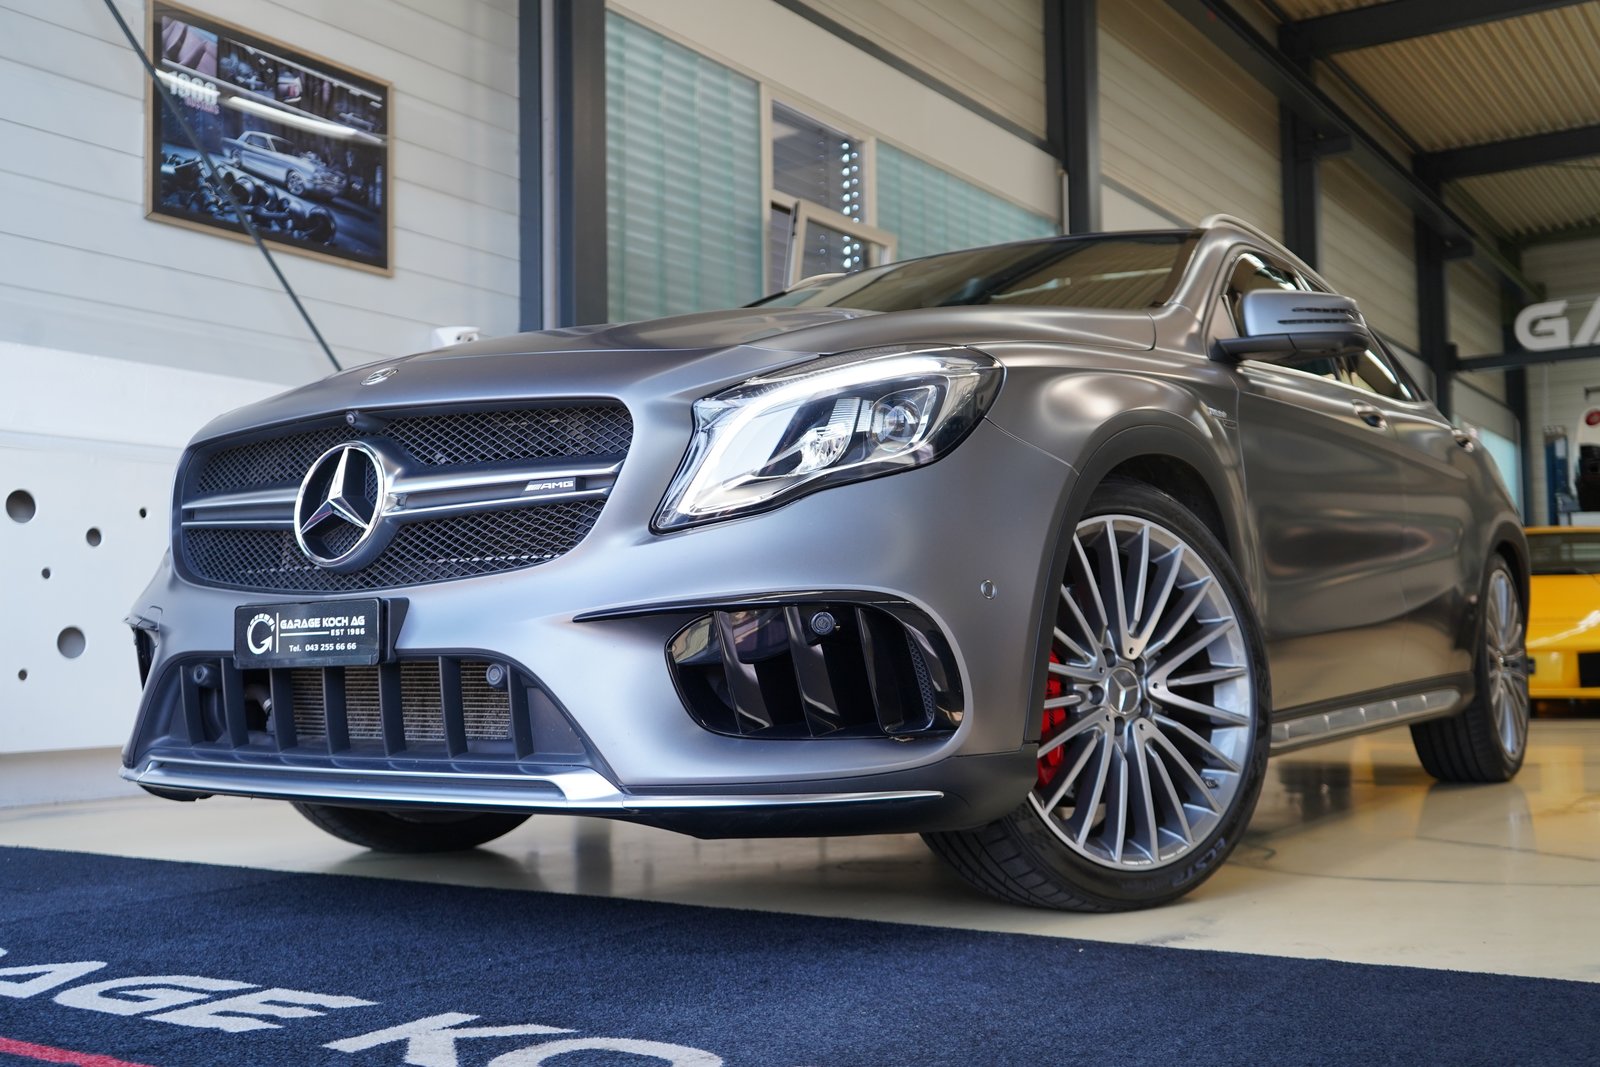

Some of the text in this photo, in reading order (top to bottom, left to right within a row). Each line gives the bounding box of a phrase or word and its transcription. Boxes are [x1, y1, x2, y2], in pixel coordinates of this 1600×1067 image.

[540, 481, 574, 489] AMG
[280, 615, 365, 630] GARAGE KOCH AG
[330, 628, 366, 637] EST 1986
[305, 643, 319, 652] 043
[320, 643, 334, 651] 255
[336, 643, 346, 651] 66
[347, 642, 357, 650] 66
